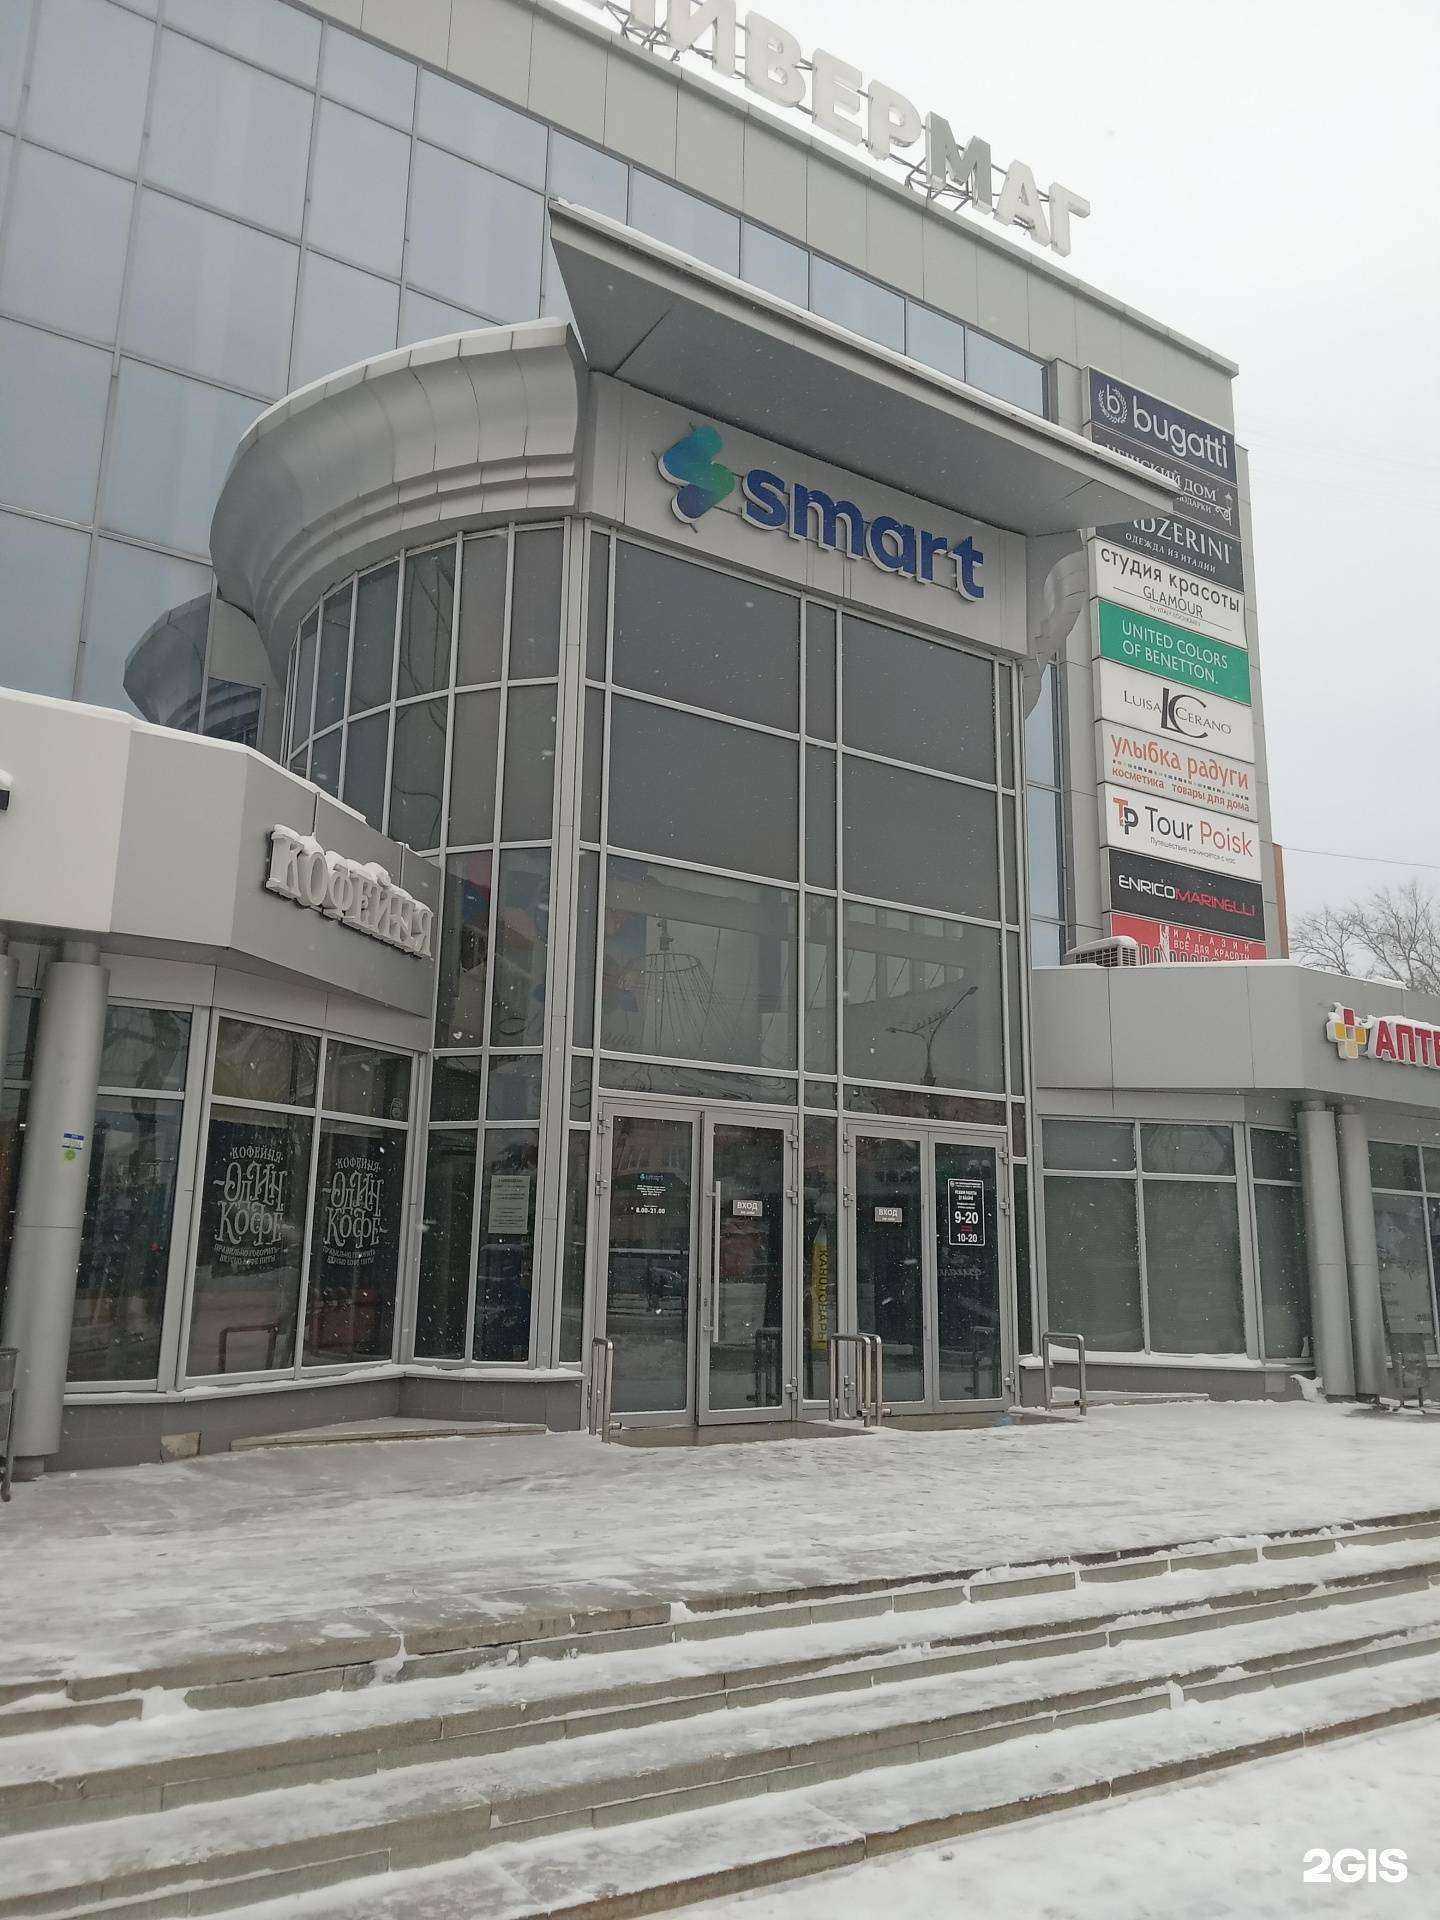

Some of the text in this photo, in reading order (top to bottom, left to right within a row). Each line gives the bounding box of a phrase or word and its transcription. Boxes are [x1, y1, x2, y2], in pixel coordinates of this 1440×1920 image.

[1133, 396, 1228, 469] bugatti
[1183, 478, 1217, 501] ДОМ
[741, 469, 985, 602] smart
[1125, 532, 1216, 574] ОДЕЖДА ИЗ ИТАЛИИ
[1143, 586, 1203, 618] GLAMOUR
[1122, 620, 1228, 669] UNITED COLORS
[1122, 640, 1142, 658] OF
[1112, 768, 1250, 812] косметика товары для дома
[1144, 806, 1253, 857] Tour Poisk
[1194, 944, 1210, 955] ДЛЯ
[737, 1201, 758, 1211] ВХОД
[878, 1208, 898, 1217] ВХОД
[954, 1210, 979, 1224] 9-20
[957, 1233, 978, 1243] 10-20
